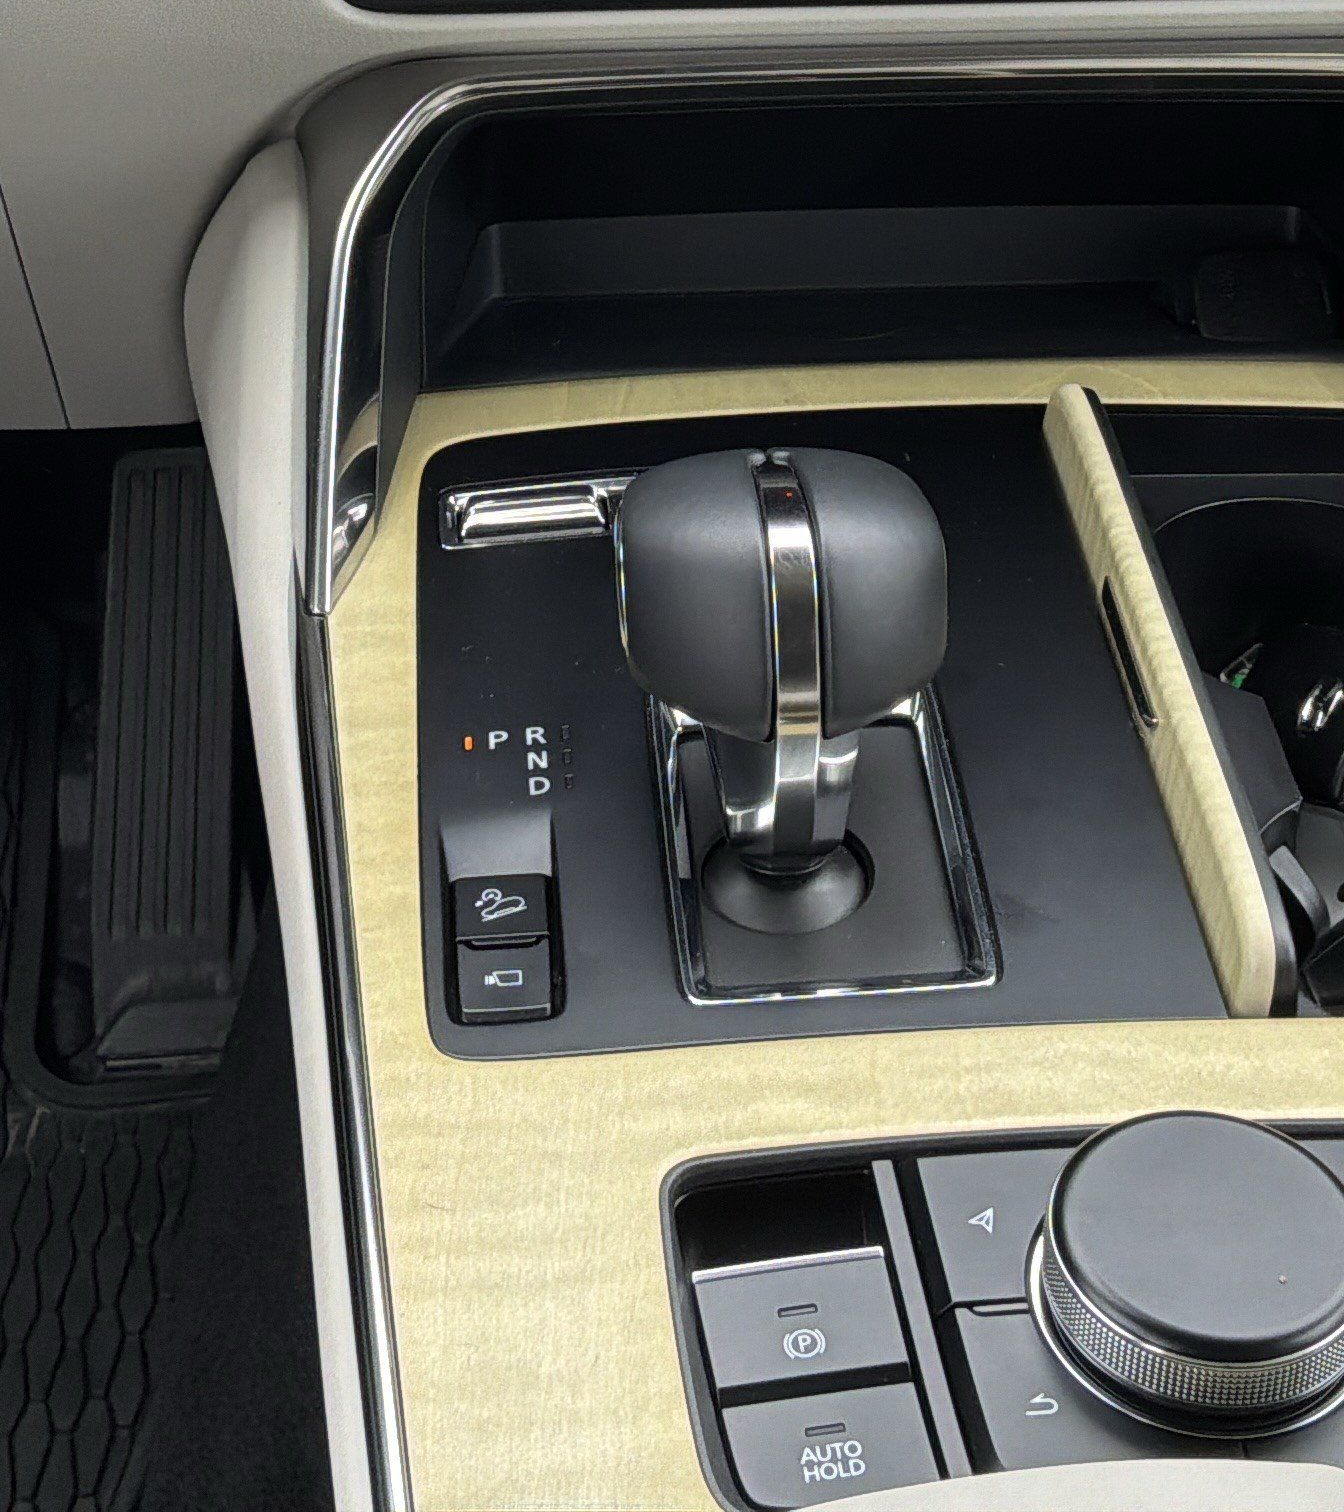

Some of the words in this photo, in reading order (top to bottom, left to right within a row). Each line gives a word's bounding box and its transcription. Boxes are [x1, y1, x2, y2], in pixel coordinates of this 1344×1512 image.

[488, 730, 509, 750] P
[525, 726, 547, 746] R
[527, 750, 548, 770] N
[528, 776, 551, 796] D
[800, 1440, 862, 1465] AUTO
[802, 1458, 866, 1484] HOLD
